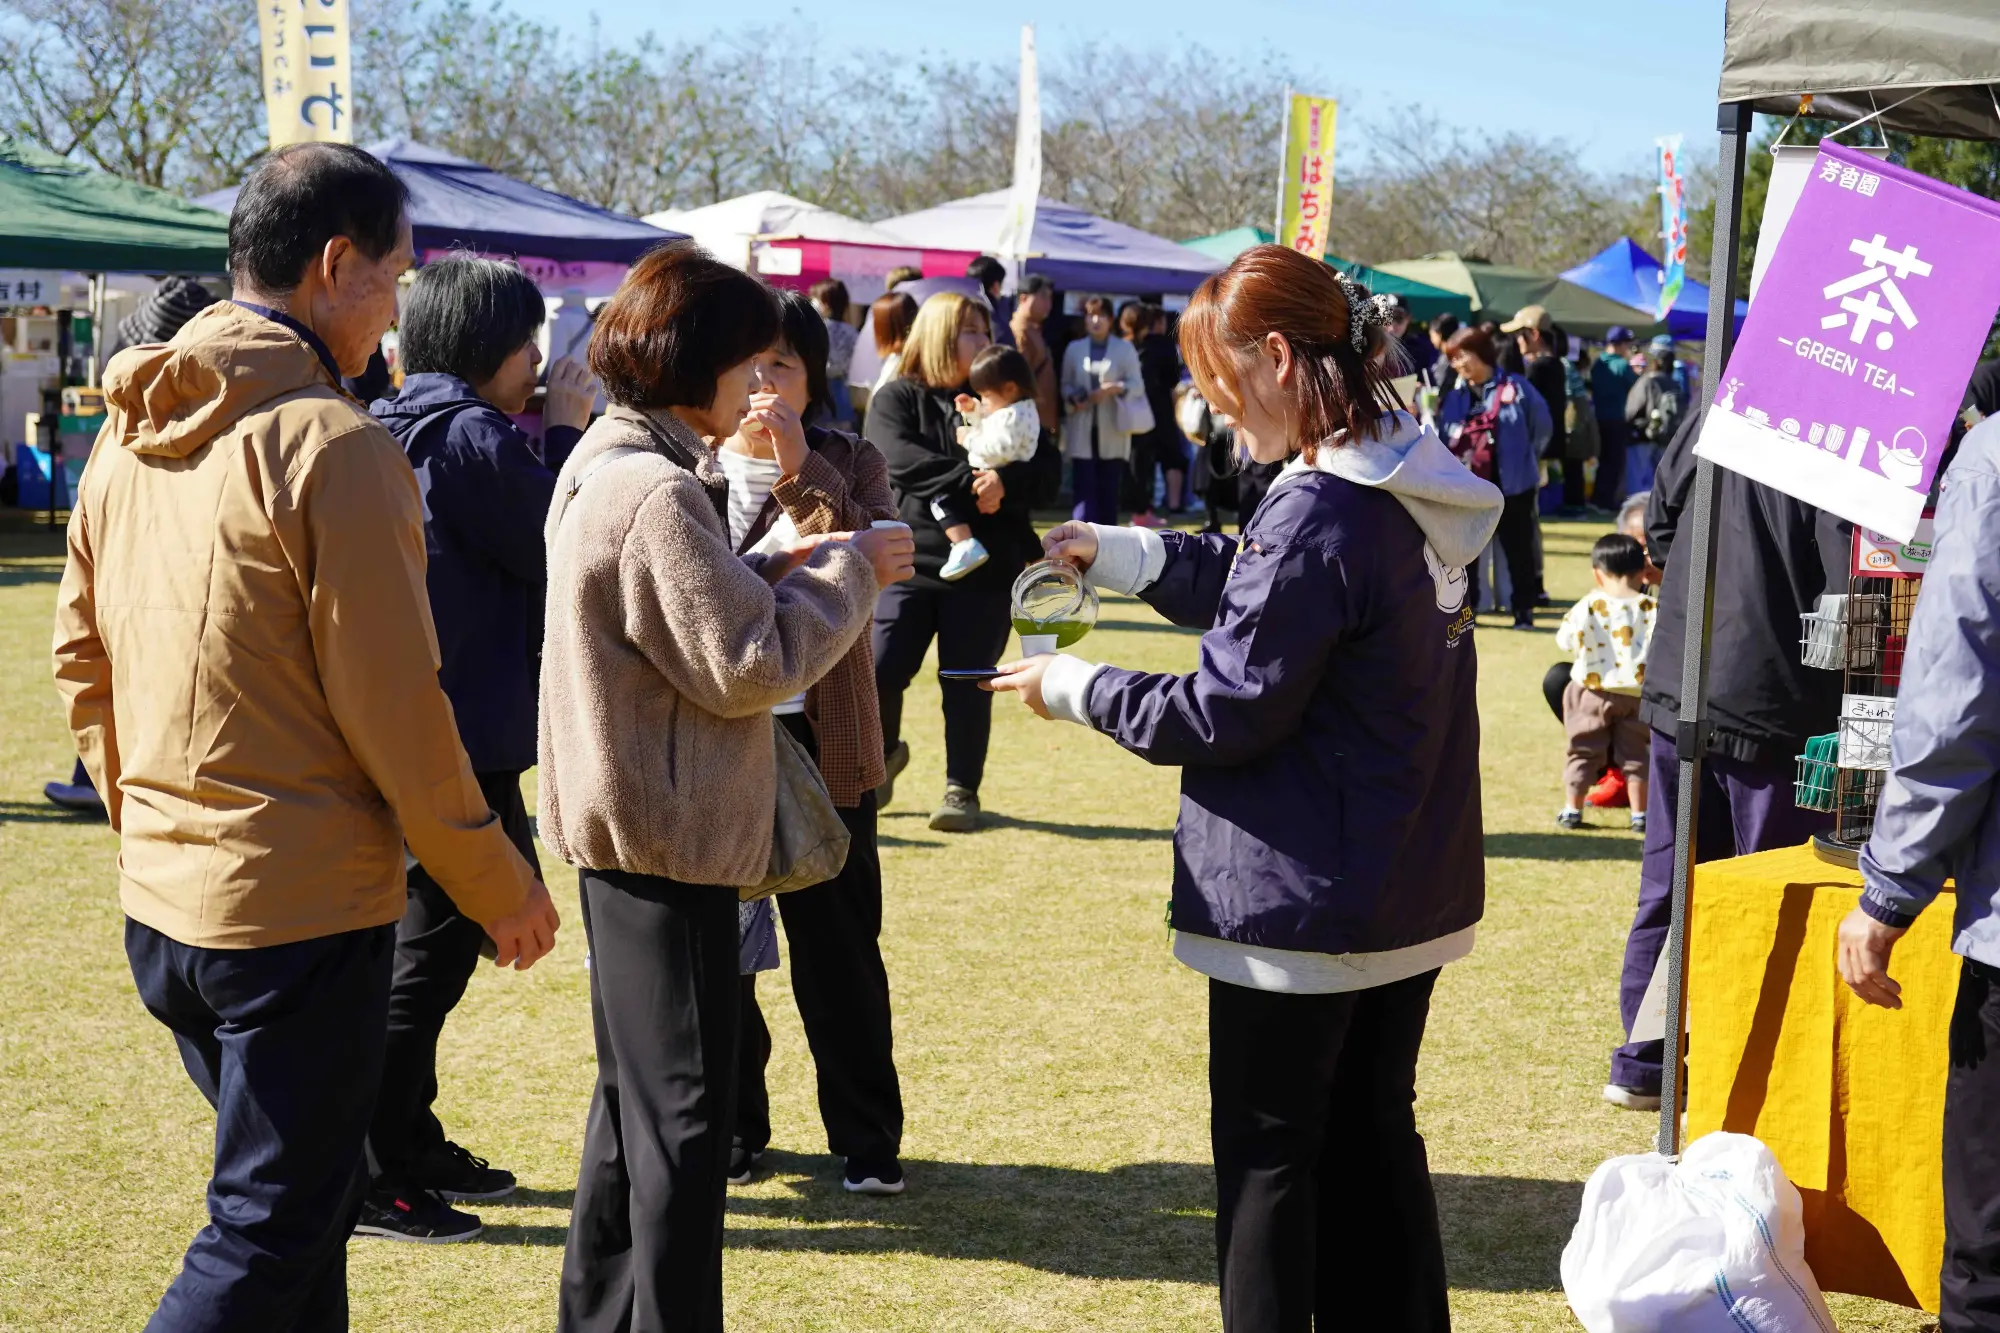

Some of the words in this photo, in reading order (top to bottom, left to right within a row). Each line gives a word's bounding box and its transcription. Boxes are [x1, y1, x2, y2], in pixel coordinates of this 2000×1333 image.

[1819, 160, 1881, 197] 芳香園
[1821, 233, 1933, 351] 茶
